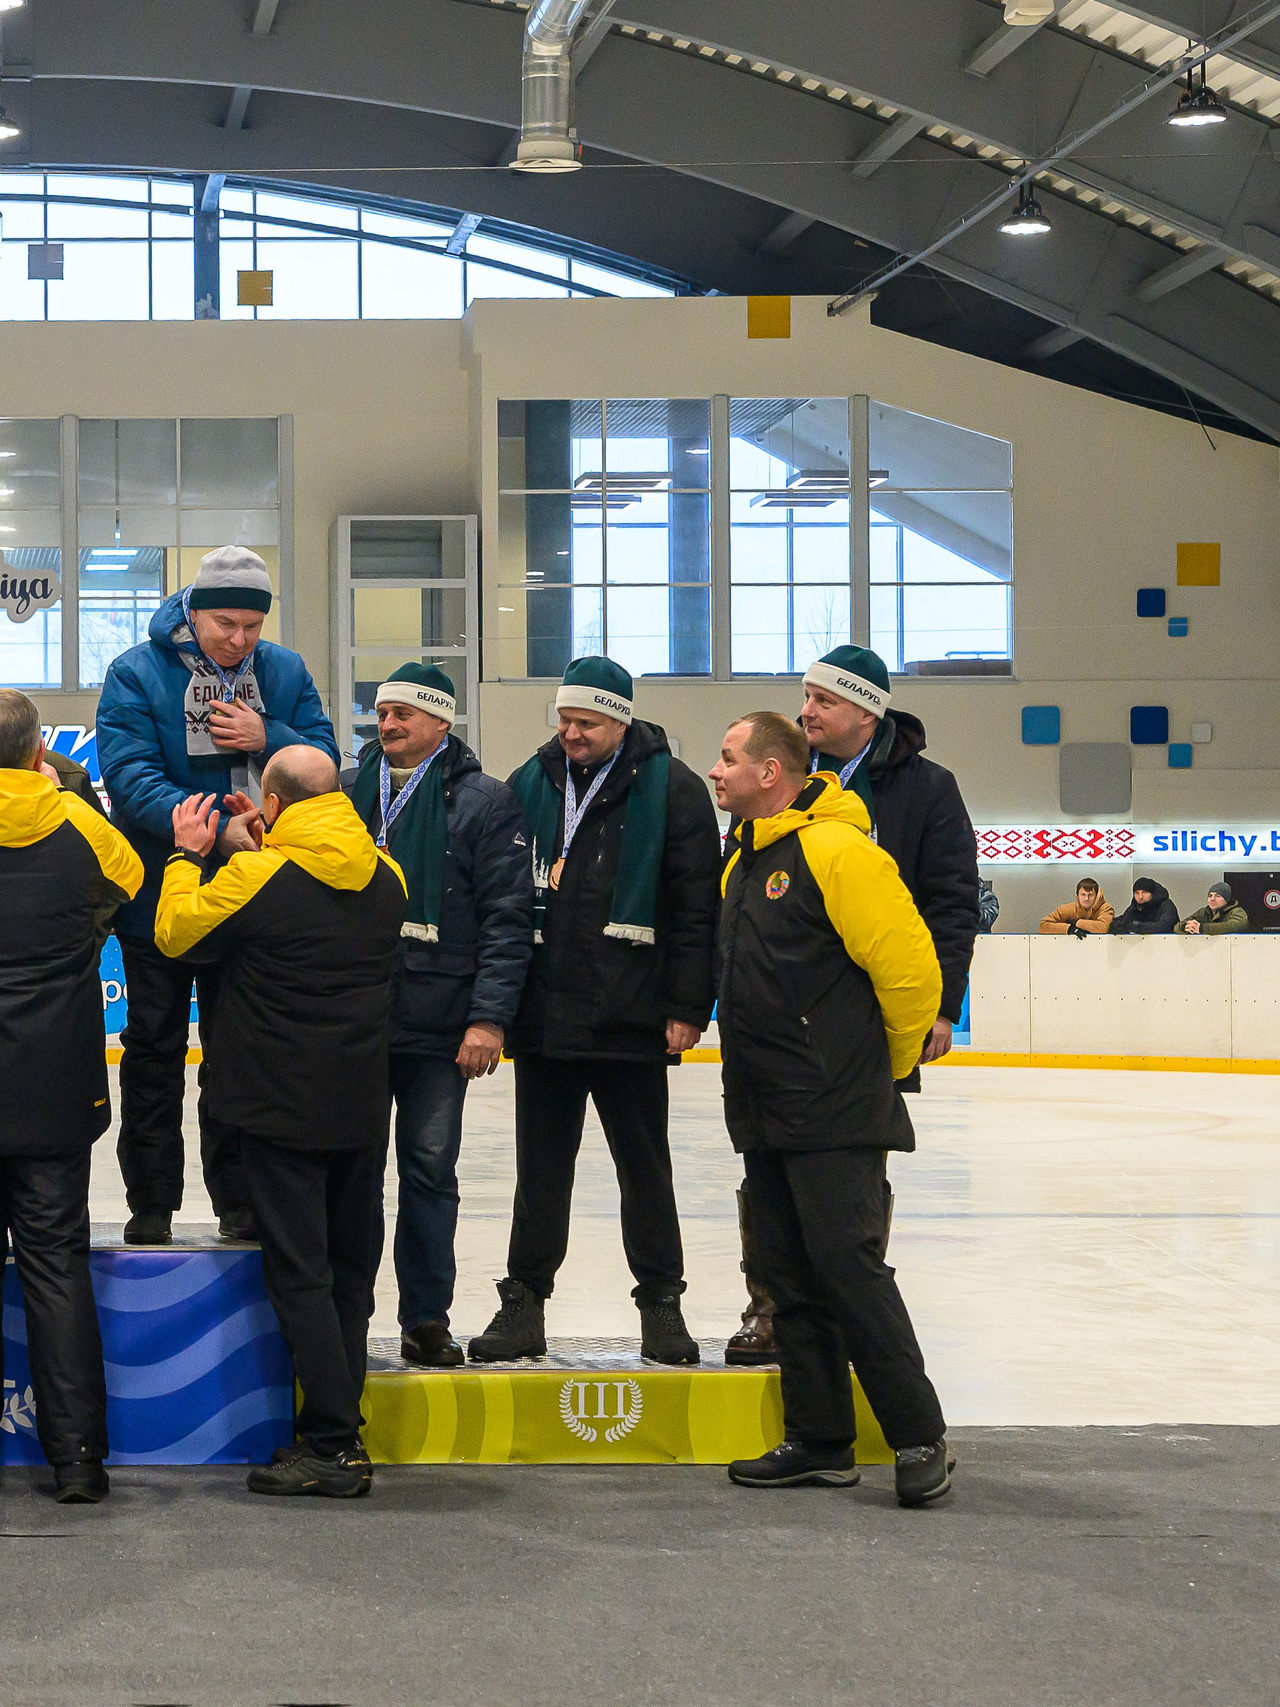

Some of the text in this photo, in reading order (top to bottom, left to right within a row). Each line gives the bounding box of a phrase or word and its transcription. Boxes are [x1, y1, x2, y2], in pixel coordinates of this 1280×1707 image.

[193, 683, 255, 706] ЕДИЫЕ
[836, 677, 882, 706] БЕЛАРУСЬ
[573, 1382, 629, 1418] III
